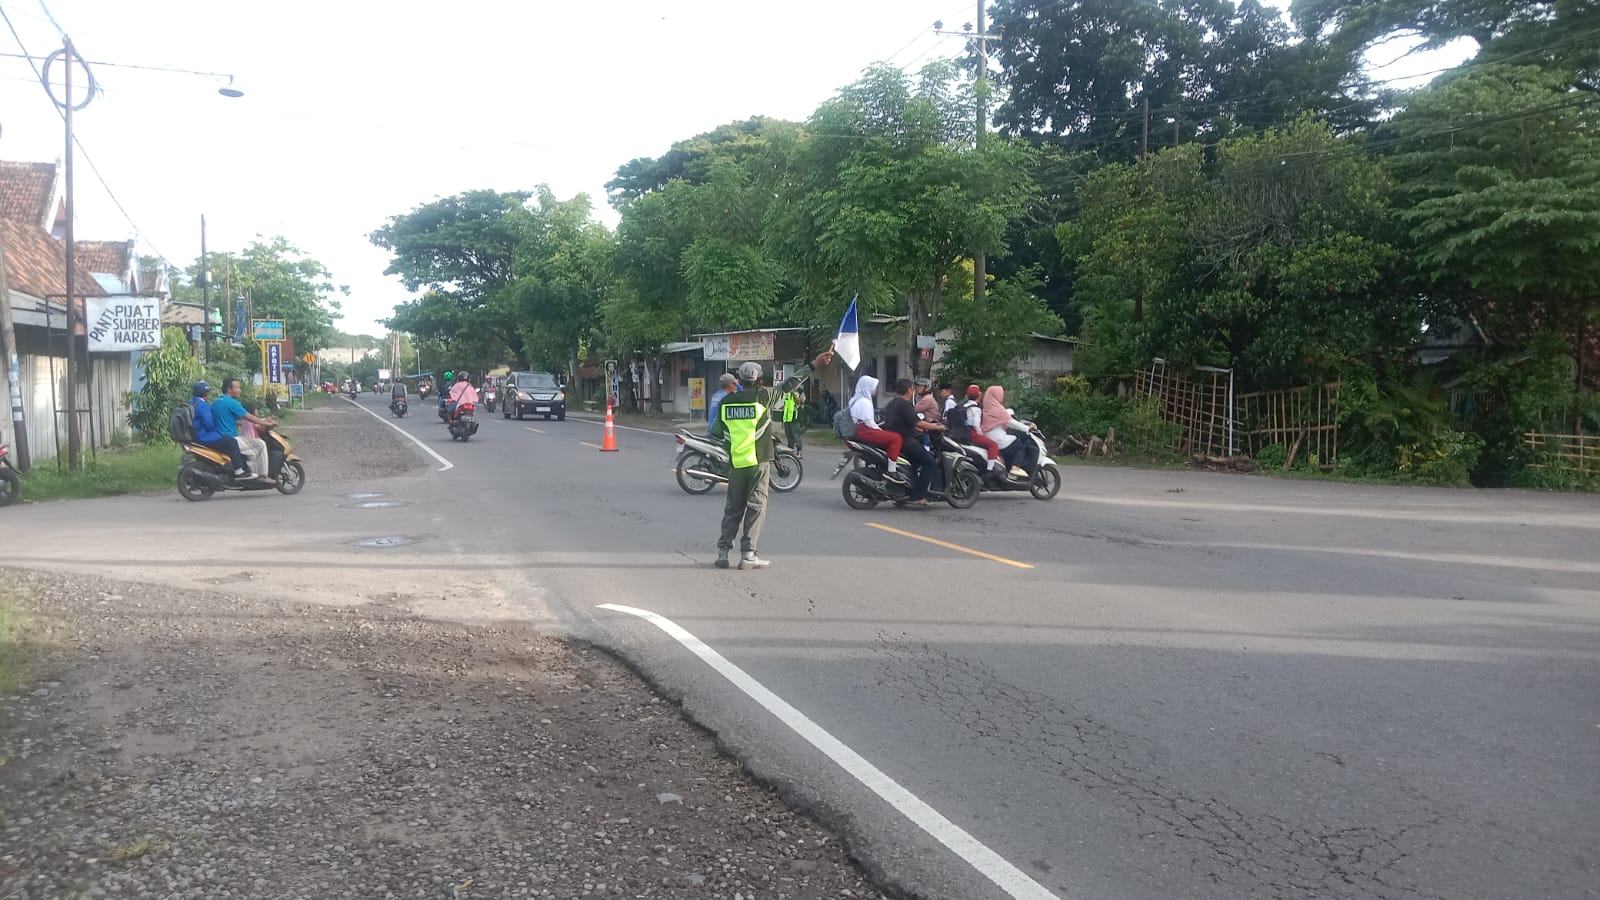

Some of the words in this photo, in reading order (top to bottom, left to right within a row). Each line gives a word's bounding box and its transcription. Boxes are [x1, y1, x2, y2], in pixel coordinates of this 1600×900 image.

[115, 305, 154, 317] PIJAT
[89, 308, 115, 343] PANTI
[113, 319, 160, 330] SUMBER
[114, 331, 155, 343] WARAS
[726, 407, 755, 418] LINMAS
